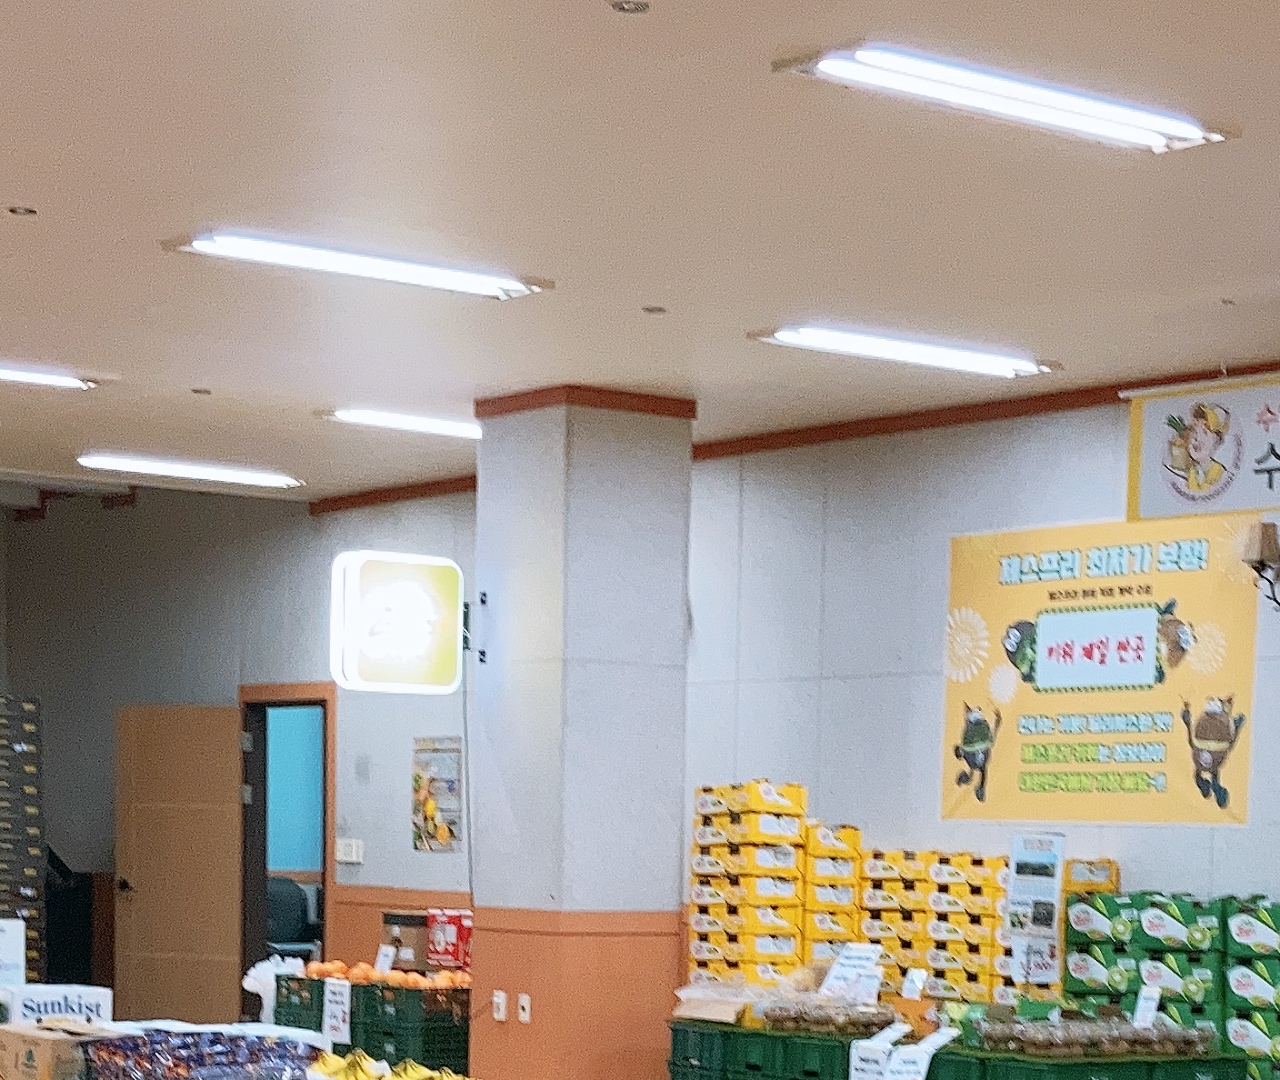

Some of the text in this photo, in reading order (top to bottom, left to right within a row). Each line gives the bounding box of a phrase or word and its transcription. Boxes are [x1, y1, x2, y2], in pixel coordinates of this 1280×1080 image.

[999, 550, 1081, 585] 제스프리
[1085, 543, 1153, 577] 최저가
[22, 995, 102, 1018] Sunkist
